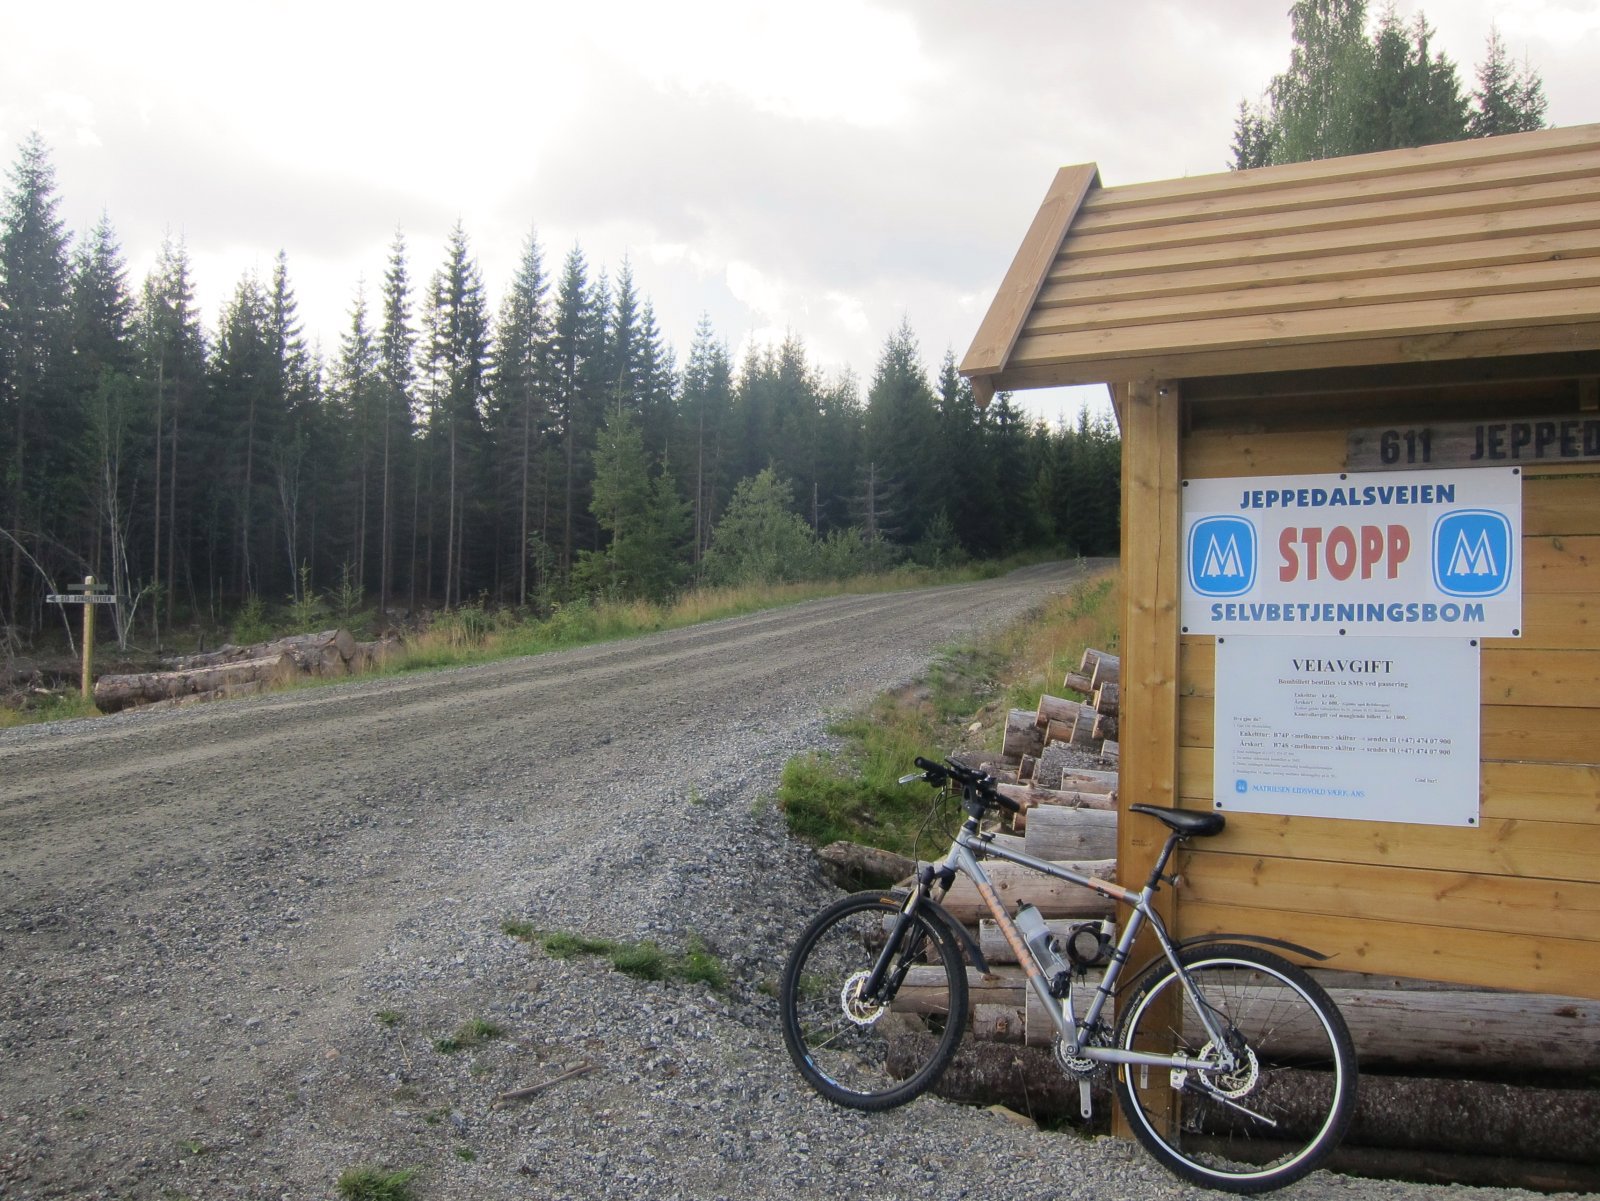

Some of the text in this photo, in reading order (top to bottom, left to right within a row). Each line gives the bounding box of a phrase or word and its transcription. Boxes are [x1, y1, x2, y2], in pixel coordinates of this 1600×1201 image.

[1380, 421, 1600, 465] 611 JEPPED
[1240, 484, 1456, 509] JEPPEDALSVEIEN
[1278, 524, 1411, 583] STOPP
[1210, 602, 1485, 623] SELVBETJENINGSBOM
[1292, 659, 1394, 674] VEIAVGIFT
[1377, 681, 1409, 689] passering
